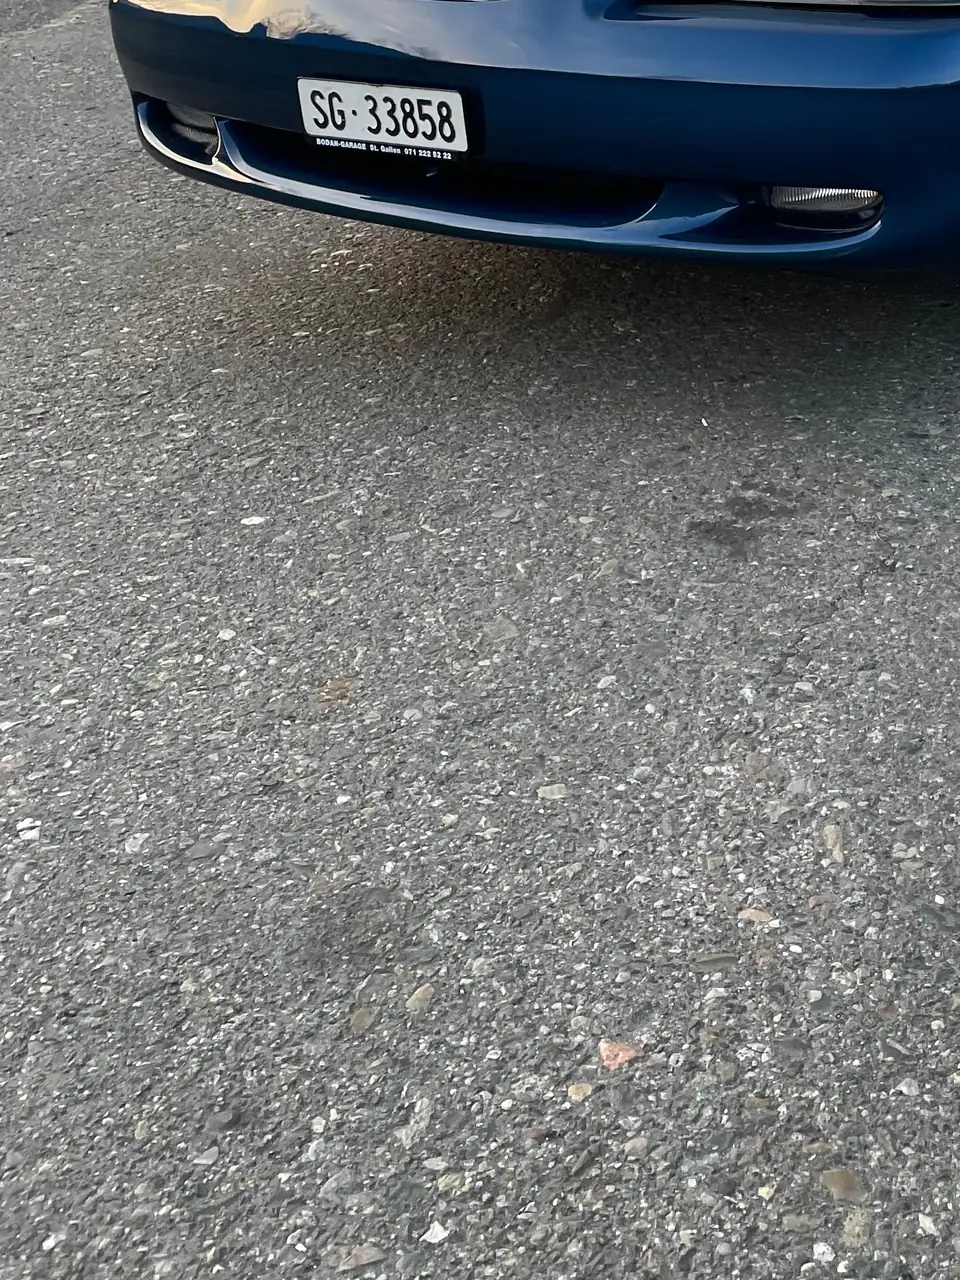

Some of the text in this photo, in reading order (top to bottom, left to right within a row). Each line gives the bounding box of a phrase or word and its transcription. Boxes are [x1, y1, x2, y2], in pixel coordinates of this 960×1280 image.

[310, 89, 456, 144] SG 33858
[315, 138, 367, 150] BODAN-GARAGE
[380, 145, 401, 154] Gallen
[404, 147, 417, 156] 071
[418, 148, 432, 158] 222
